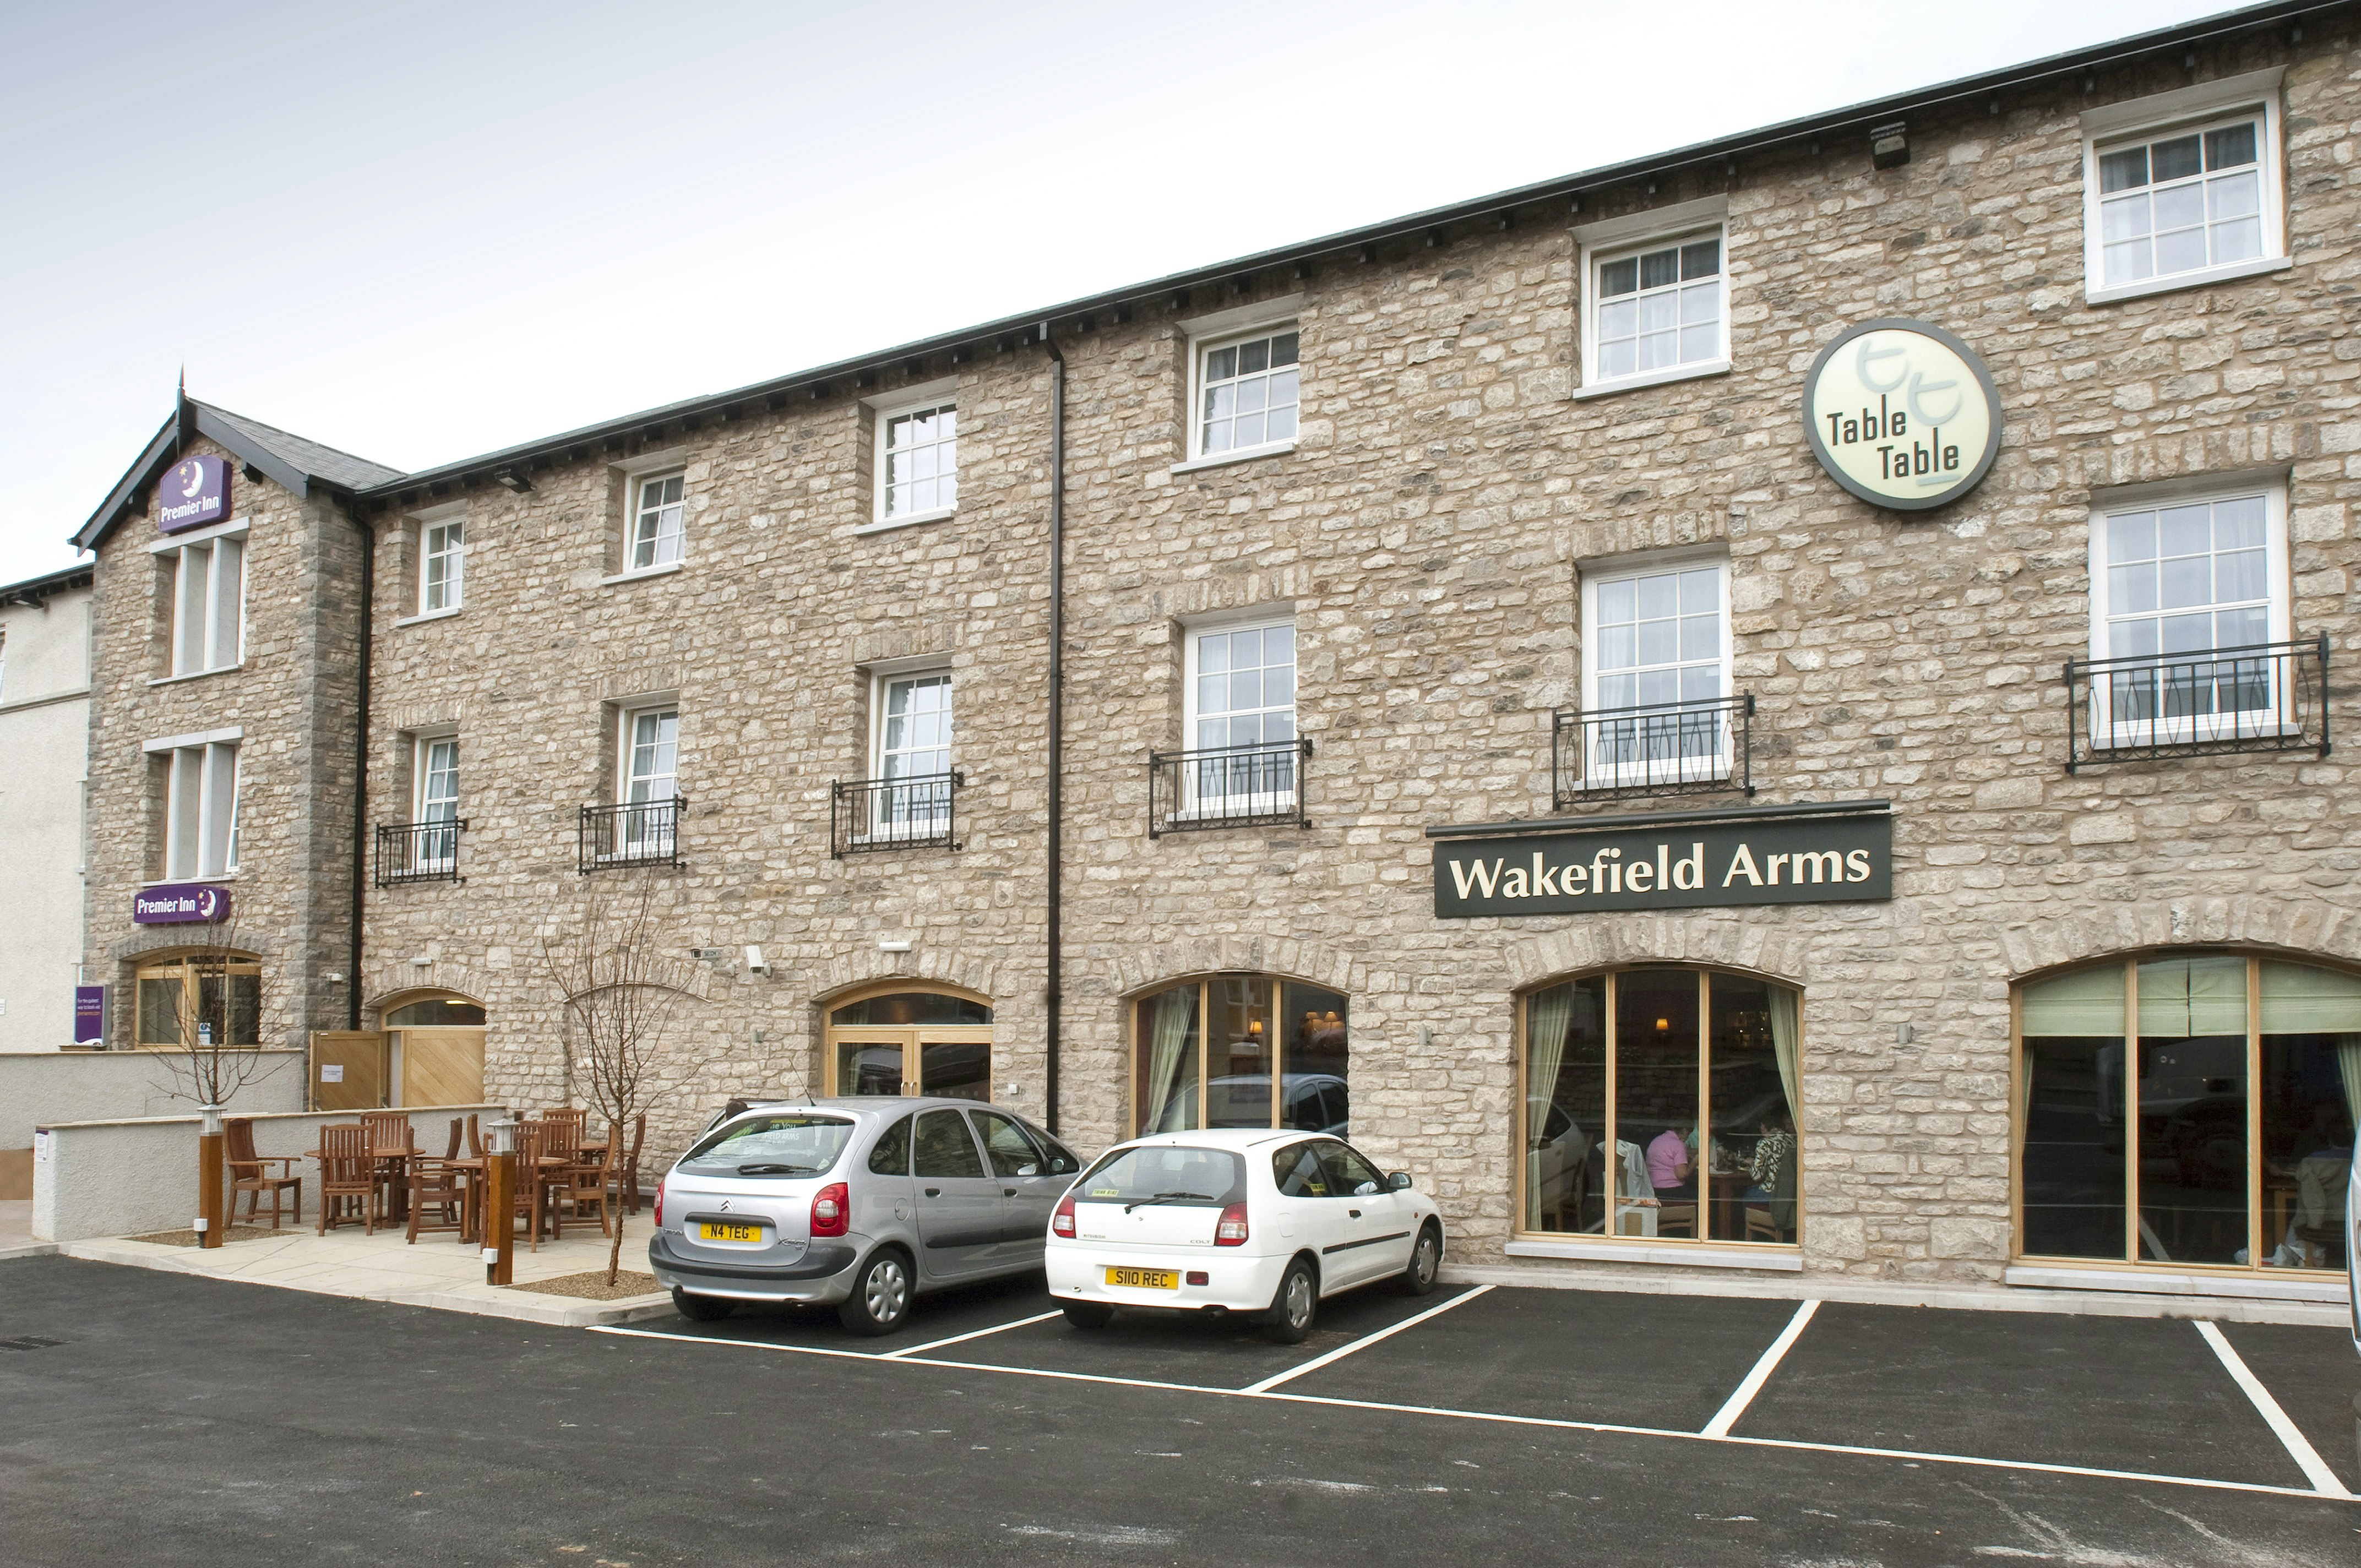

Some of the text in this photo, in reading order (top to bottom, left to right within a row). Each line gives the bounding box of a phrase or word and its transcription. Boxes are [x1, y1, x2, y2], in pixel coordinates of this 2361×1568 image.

[1826, 394, 1906, 446] Table
[1876, 427, 1959, 480] Table
[161, 496, 219, 522] Premier Inn
[1448, 842, 1872, 900] Wakefield Arms
[137, 897, 195, 914] Premier Inn
[710, 1224, 749, 1239] N4 TEG
[1116, 1271, 1168, 1287] S110 REC
